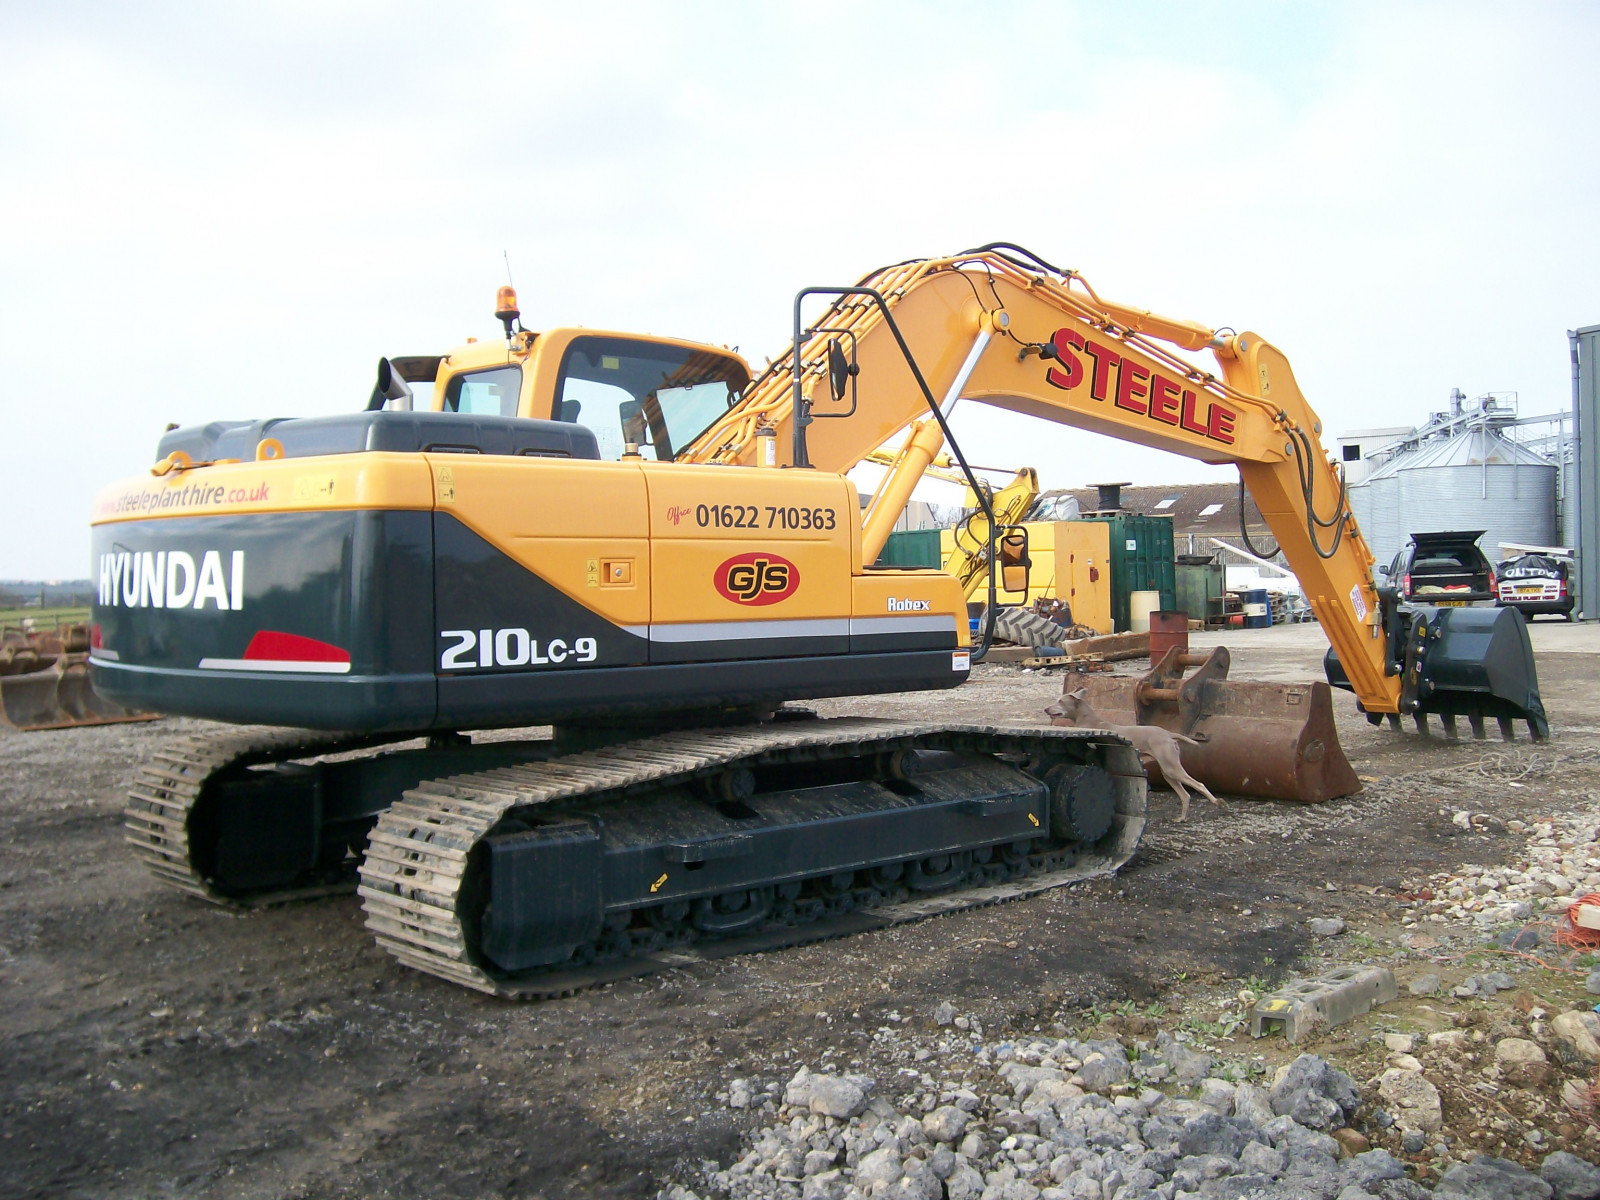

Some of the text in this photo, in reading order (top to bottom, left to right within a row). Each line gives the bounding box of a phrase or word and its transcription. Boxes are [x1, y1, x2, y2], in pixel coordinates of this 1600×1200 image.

[1046, 328, 1236, 445] STEELE
[667, 504, 836, 530] Office 01622 710363
[99, 550, 244, 611] HYUNDAI
[727, 559, 789, 601] GJS
[440, 627, 598, 669] 210LC-9
